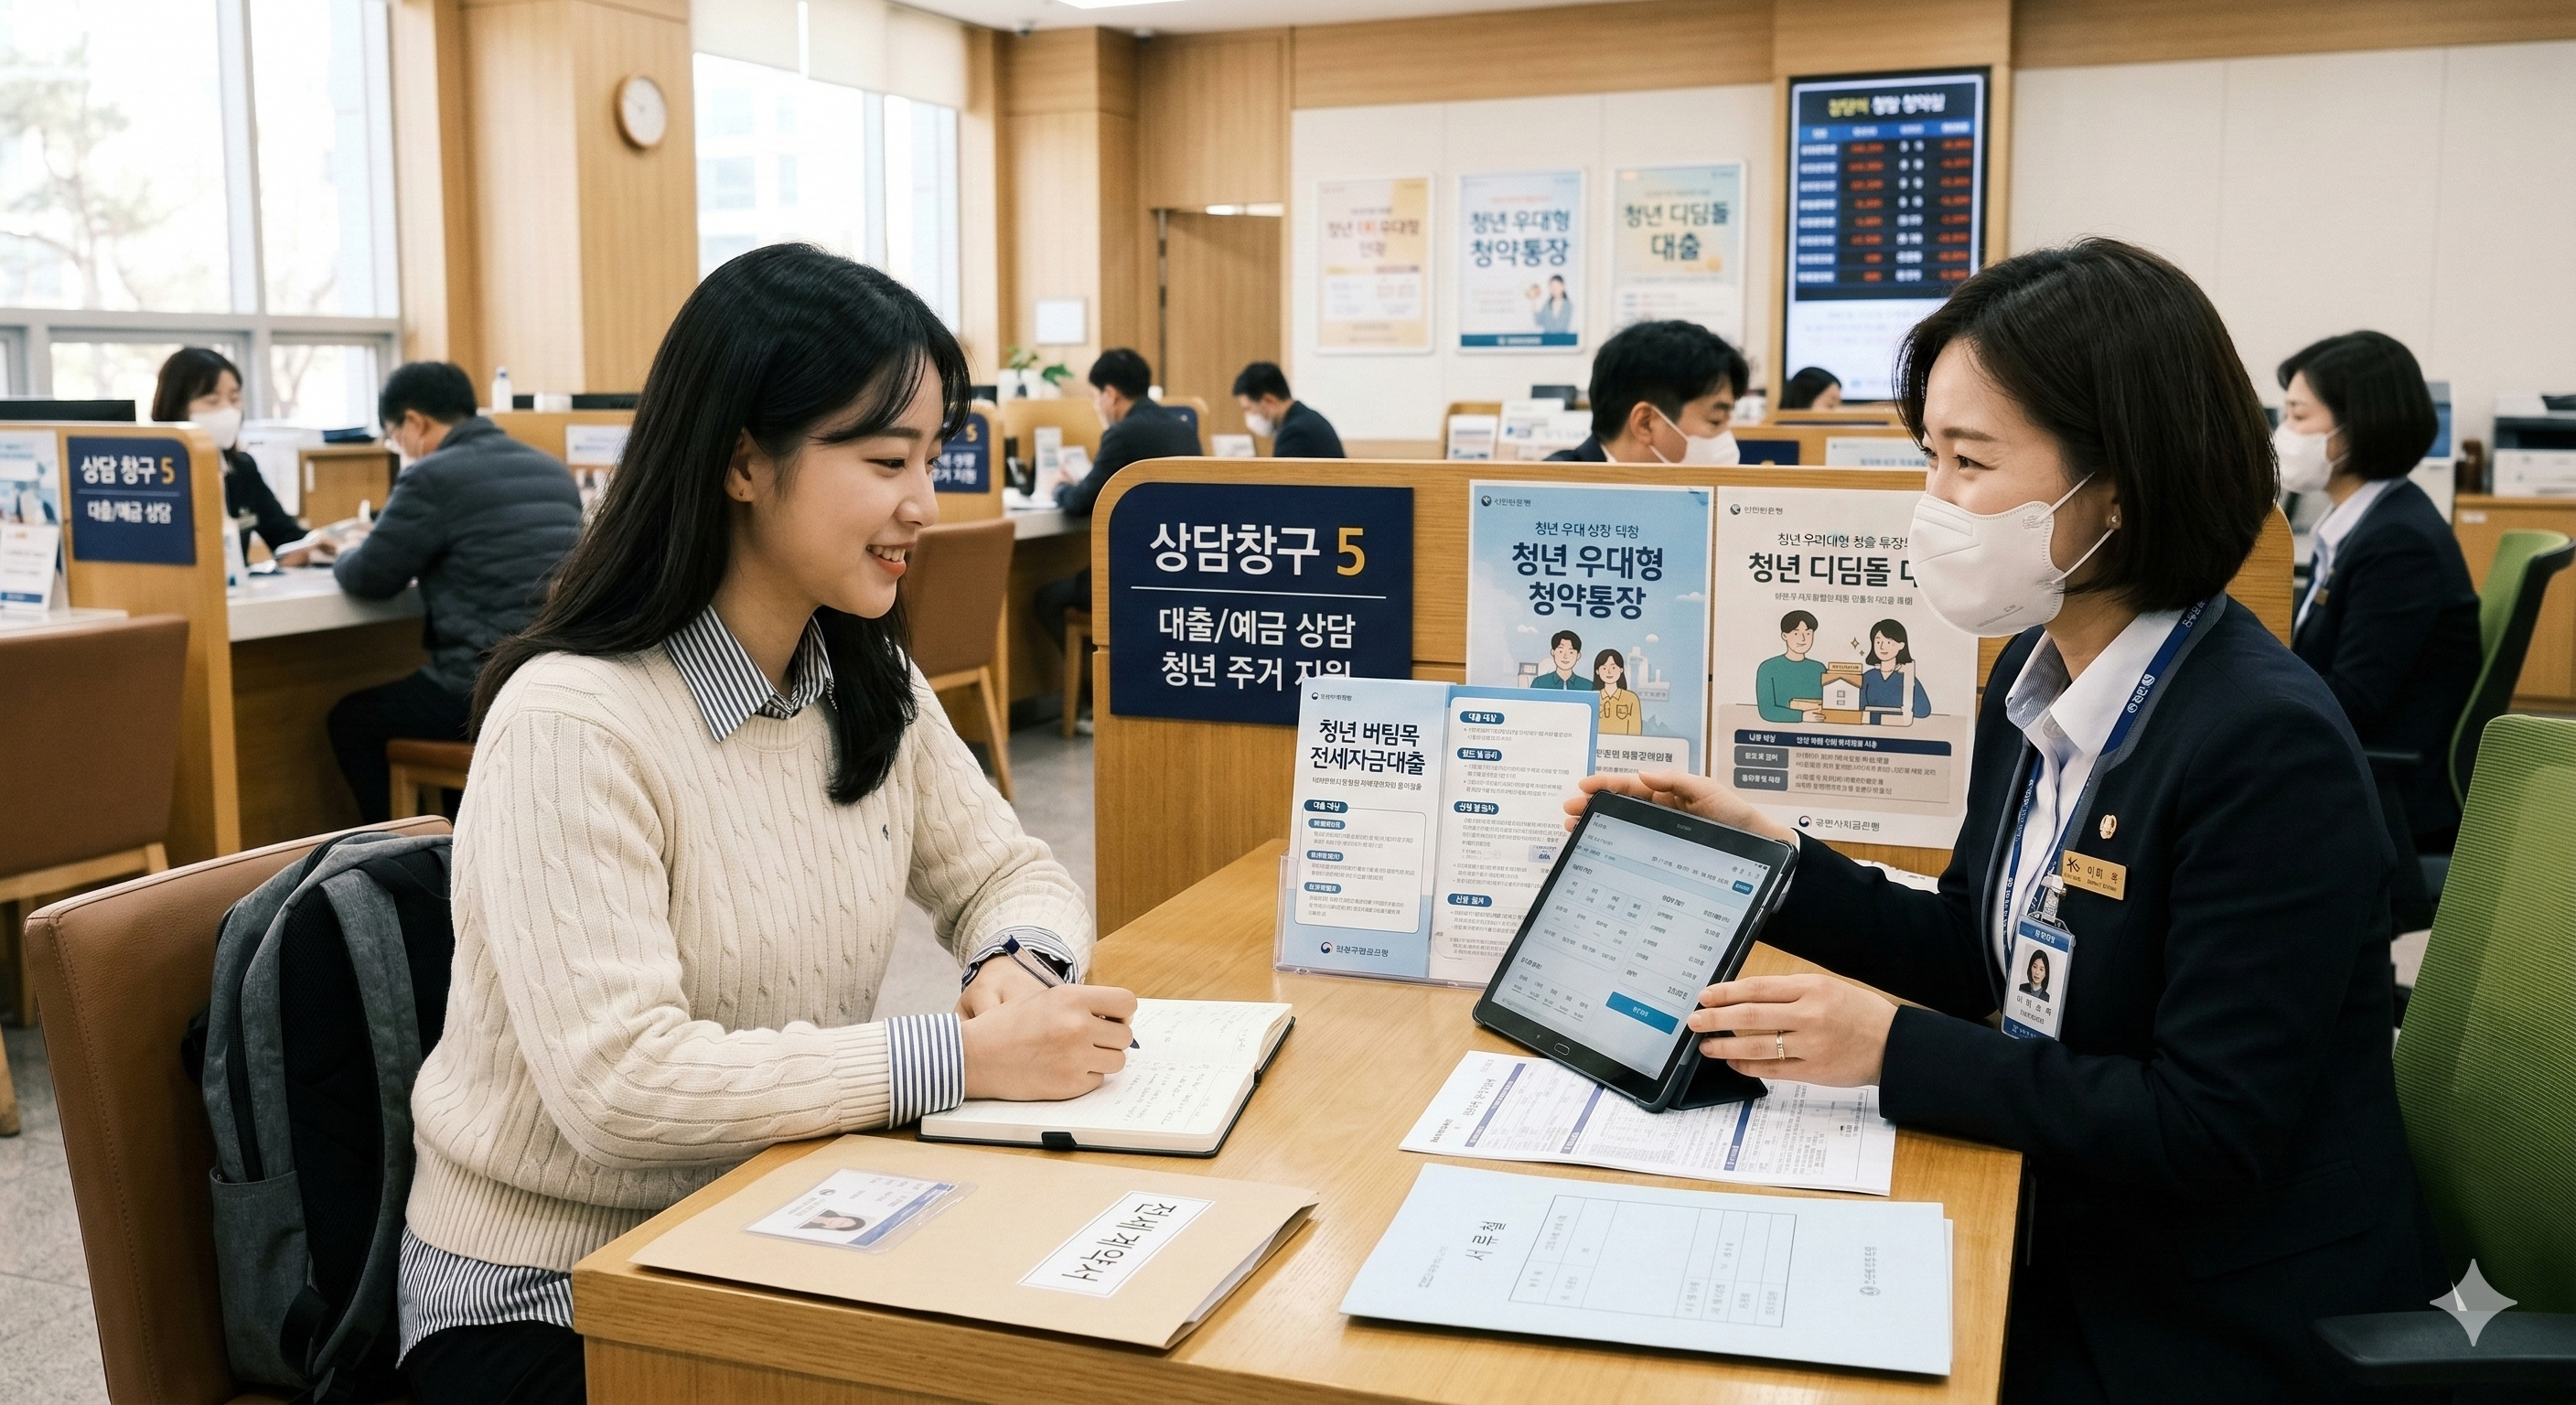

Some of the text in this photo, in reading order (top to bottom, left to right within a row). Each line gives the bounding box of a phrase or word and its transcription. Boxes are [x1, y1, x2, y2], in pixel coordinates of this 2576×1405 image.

[1471, 209, 1570, 234] 청년 우대형
[1626, 204, 1662, 228] 청년
[1470, 238, 1570, 267] 청약통장
[80, 455, 176, 485] 상담 창구 5
[1535, 520, 1558, 536] 청년
[1561, 522, 1585, 538] 우대
[1150, 522, 1366, 576] 상담창구 5
[1512, 542, 1664, 582] 청년 우대형
[1748, 552, 1801, 584] 청년
[1810, 554, 1892, 587] 디딤돌
[1529, 581, 1648, 621] 청약통장
[1158, 606, 1357, 649] 대출/예금 상담
[1161, 651, 1217, 688] 청년
[1227, 655, 1283, 692] 주거
[1319, 718, 1421, 747] 청년 버팀목
[1310, 745, 1426, 777] 전세자금대출
[1061, 1203, 1177, 1282] 전세계약서
